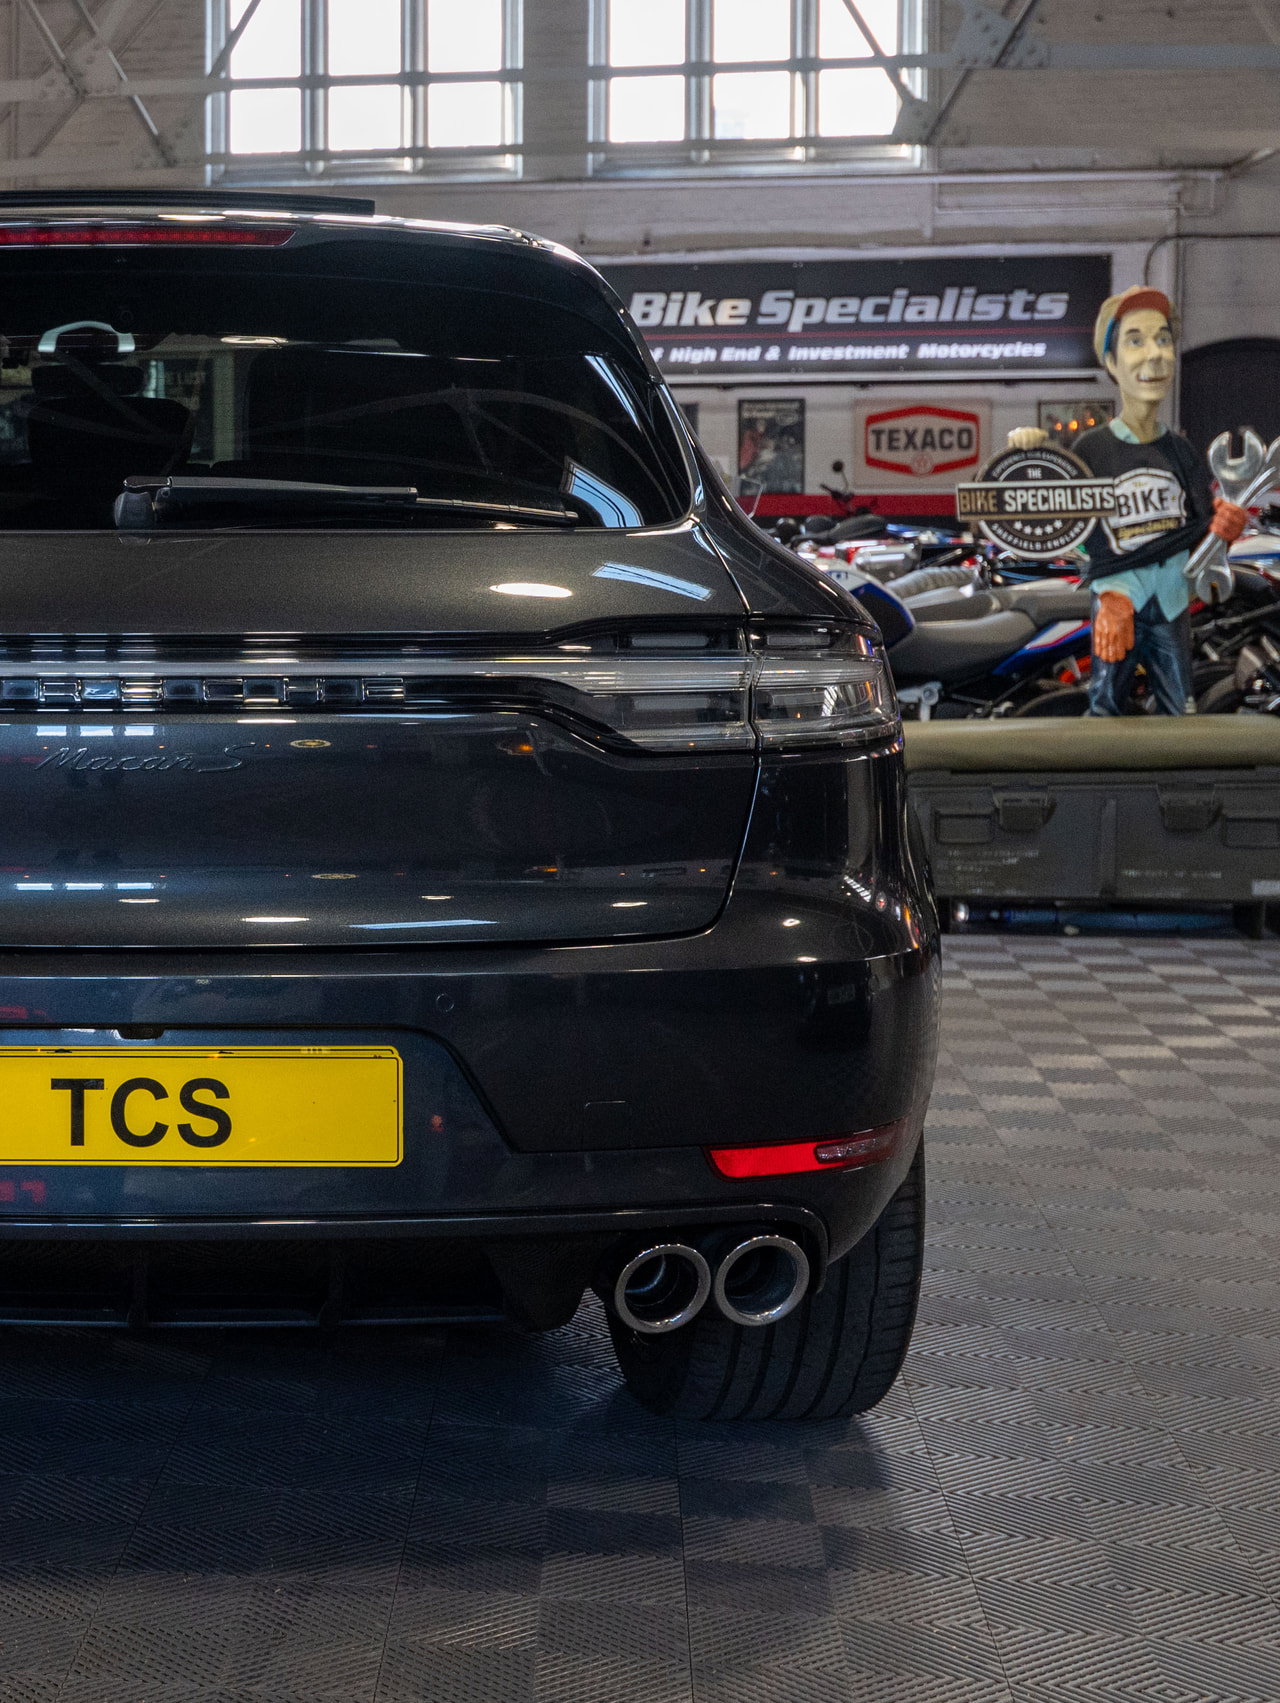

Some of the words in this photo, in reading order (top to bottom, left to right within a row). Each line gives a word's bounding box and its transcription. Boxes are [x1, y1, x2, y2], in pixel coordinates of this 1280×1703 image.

[630, 291, 752, 327] Bike
[757, 286, 1070, 332] Specialists
[669, 346, 718, 364] High
[720, 345, 762, 362] End
[764, 344, 781, 361] &
[788, 343, 910, 361] Investment
[917, 341, 1048, 360] Motorcycles
[871, 427, 974, 452] TEXACO
[1026, 468, 1042, 480] THE
[959, 489, 998, 513] BIKE
[1004, 486, 1115, 512] SPECIALISTS
[1117, 487, 1169, 518] BIKE
[34, 747, 197, 772] Macan
[197, 742, 257, 773] S
[50, 1077, 233, 1149] TCS
